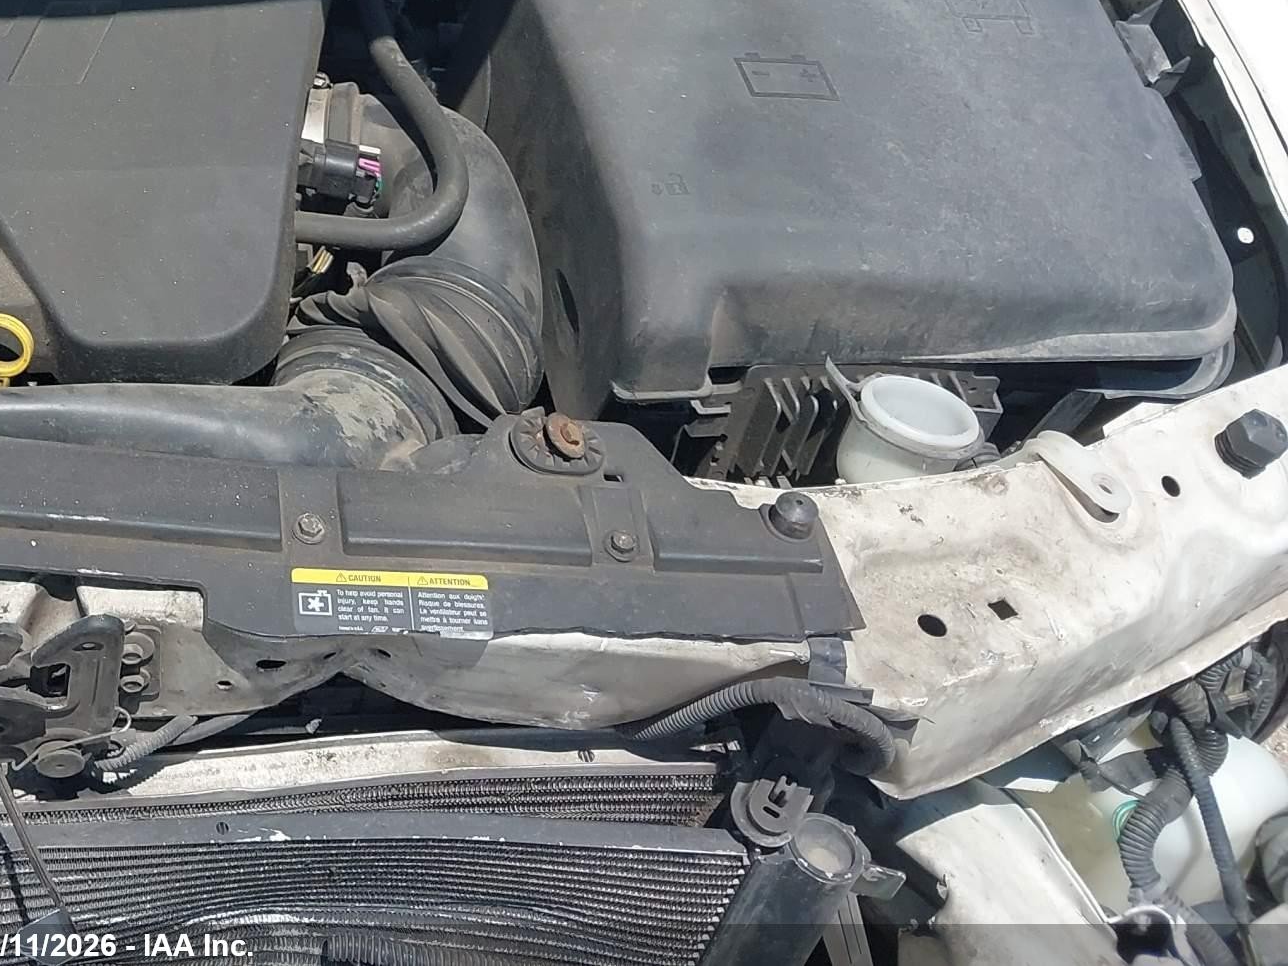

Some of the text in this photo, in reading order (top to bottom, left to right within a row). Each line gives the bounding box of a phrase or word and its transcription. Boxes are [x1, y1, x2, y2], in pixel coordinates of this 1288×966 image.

[348, 574, 382, 583] CAUTION
[429, 577, 471, 586] ATTENTION
[377, 591, 403, 599] personal
[418, 591, 445, 599] Attention
